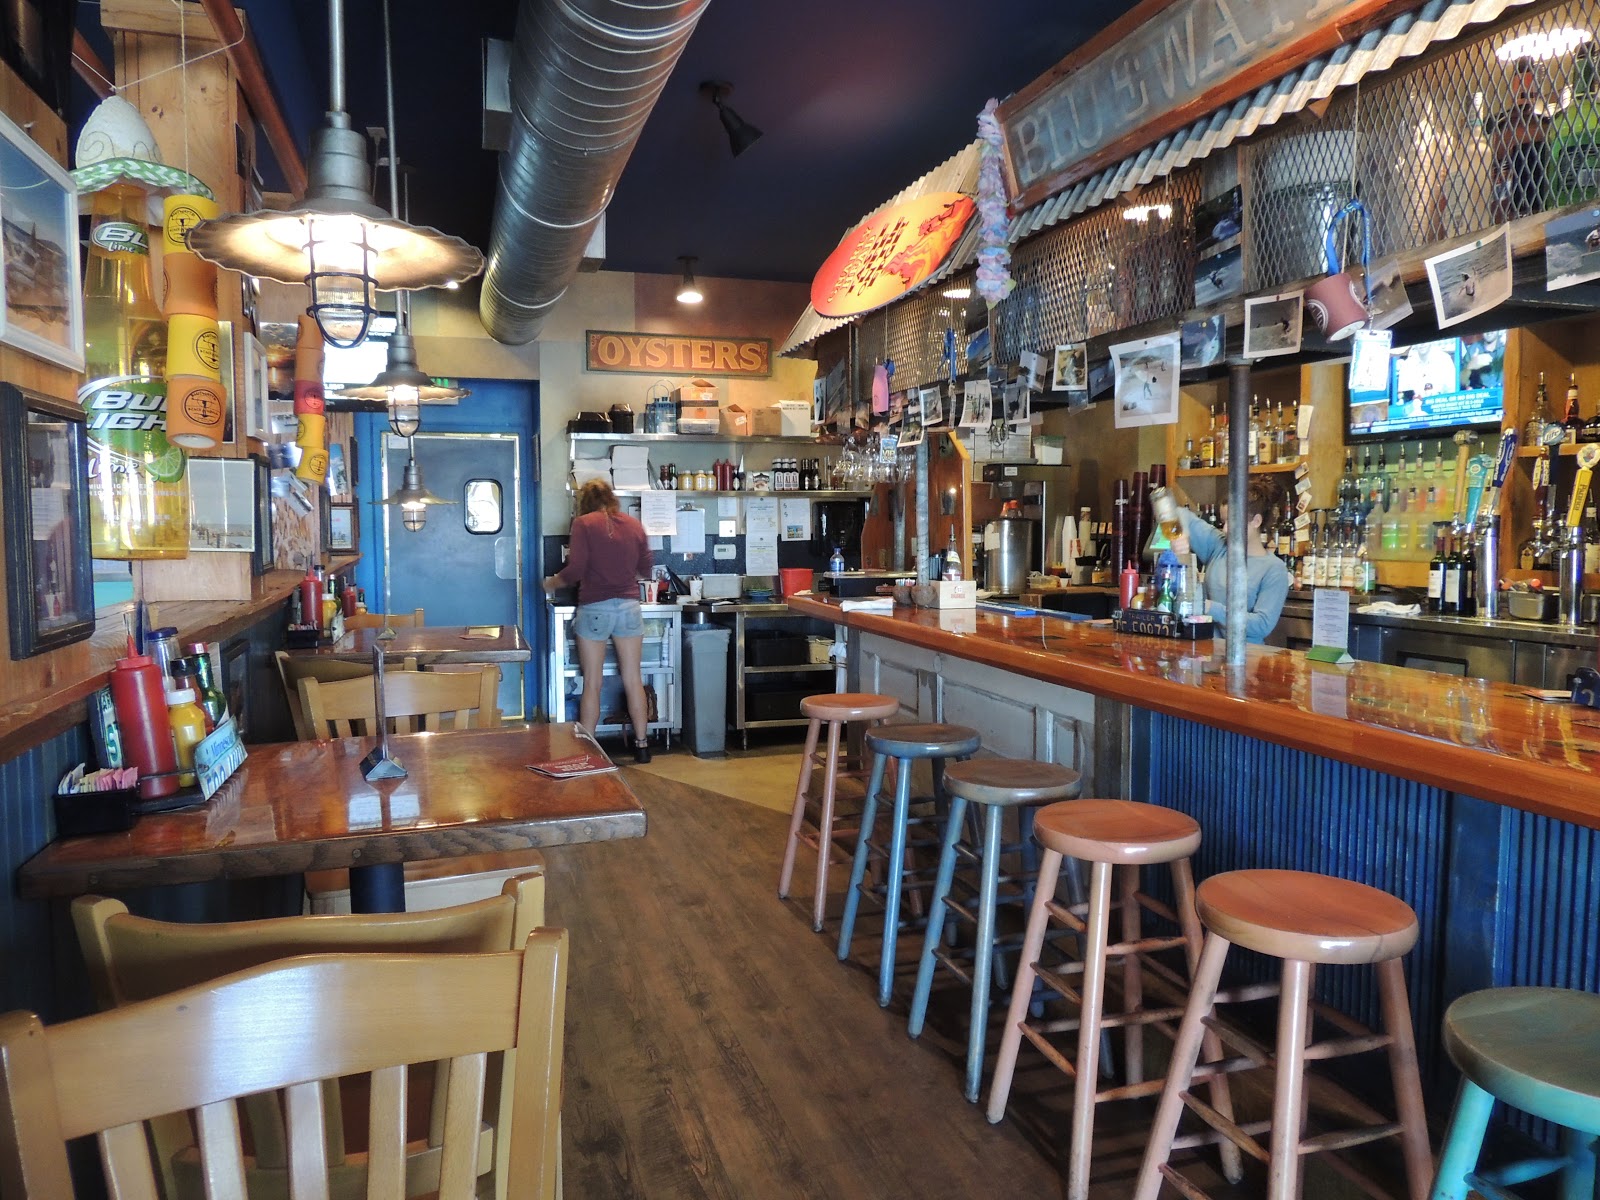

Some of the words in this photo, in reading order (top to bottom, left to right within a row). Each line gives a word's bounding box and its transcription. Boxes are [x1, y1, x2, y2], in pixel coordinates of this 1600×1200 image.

[598, 335, 762, 371] OYSTERS
[92, 390, 167, 411] BU
[86, 412, 167, 431] IGH
